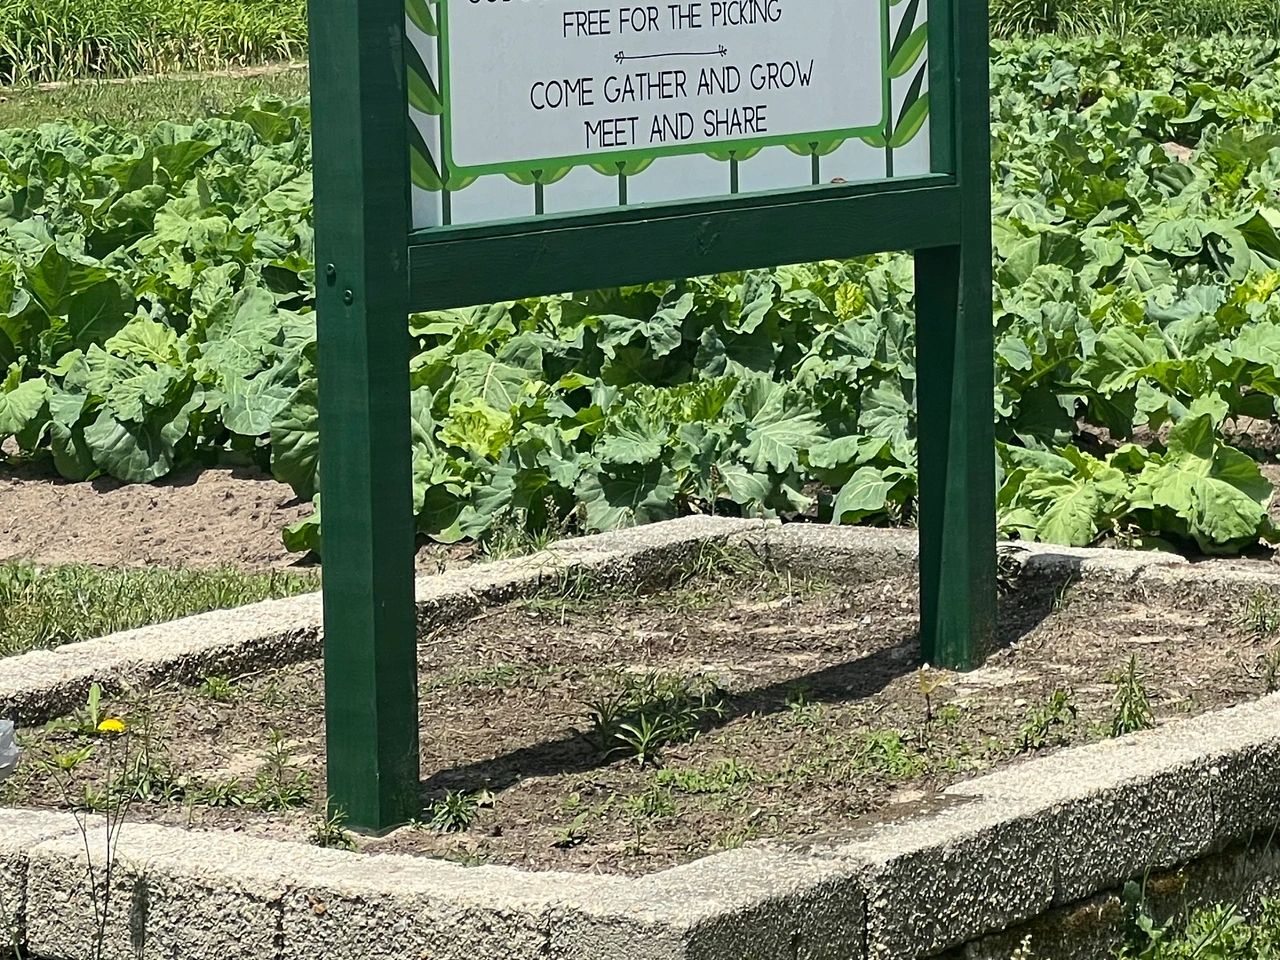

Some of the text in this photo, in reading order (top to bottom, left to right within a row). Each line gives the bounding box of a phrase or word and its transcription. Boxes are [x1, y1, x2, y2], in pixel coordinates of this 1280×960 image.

[563, 9, 611, 38] FREE
[619, 6, 660, 34] FOR
[667, 3, 702, 30] THE
[530, 59, 814, 110] COME GATHER AND GROW
[584, 105, 768, 149] MEET AND SHARE
